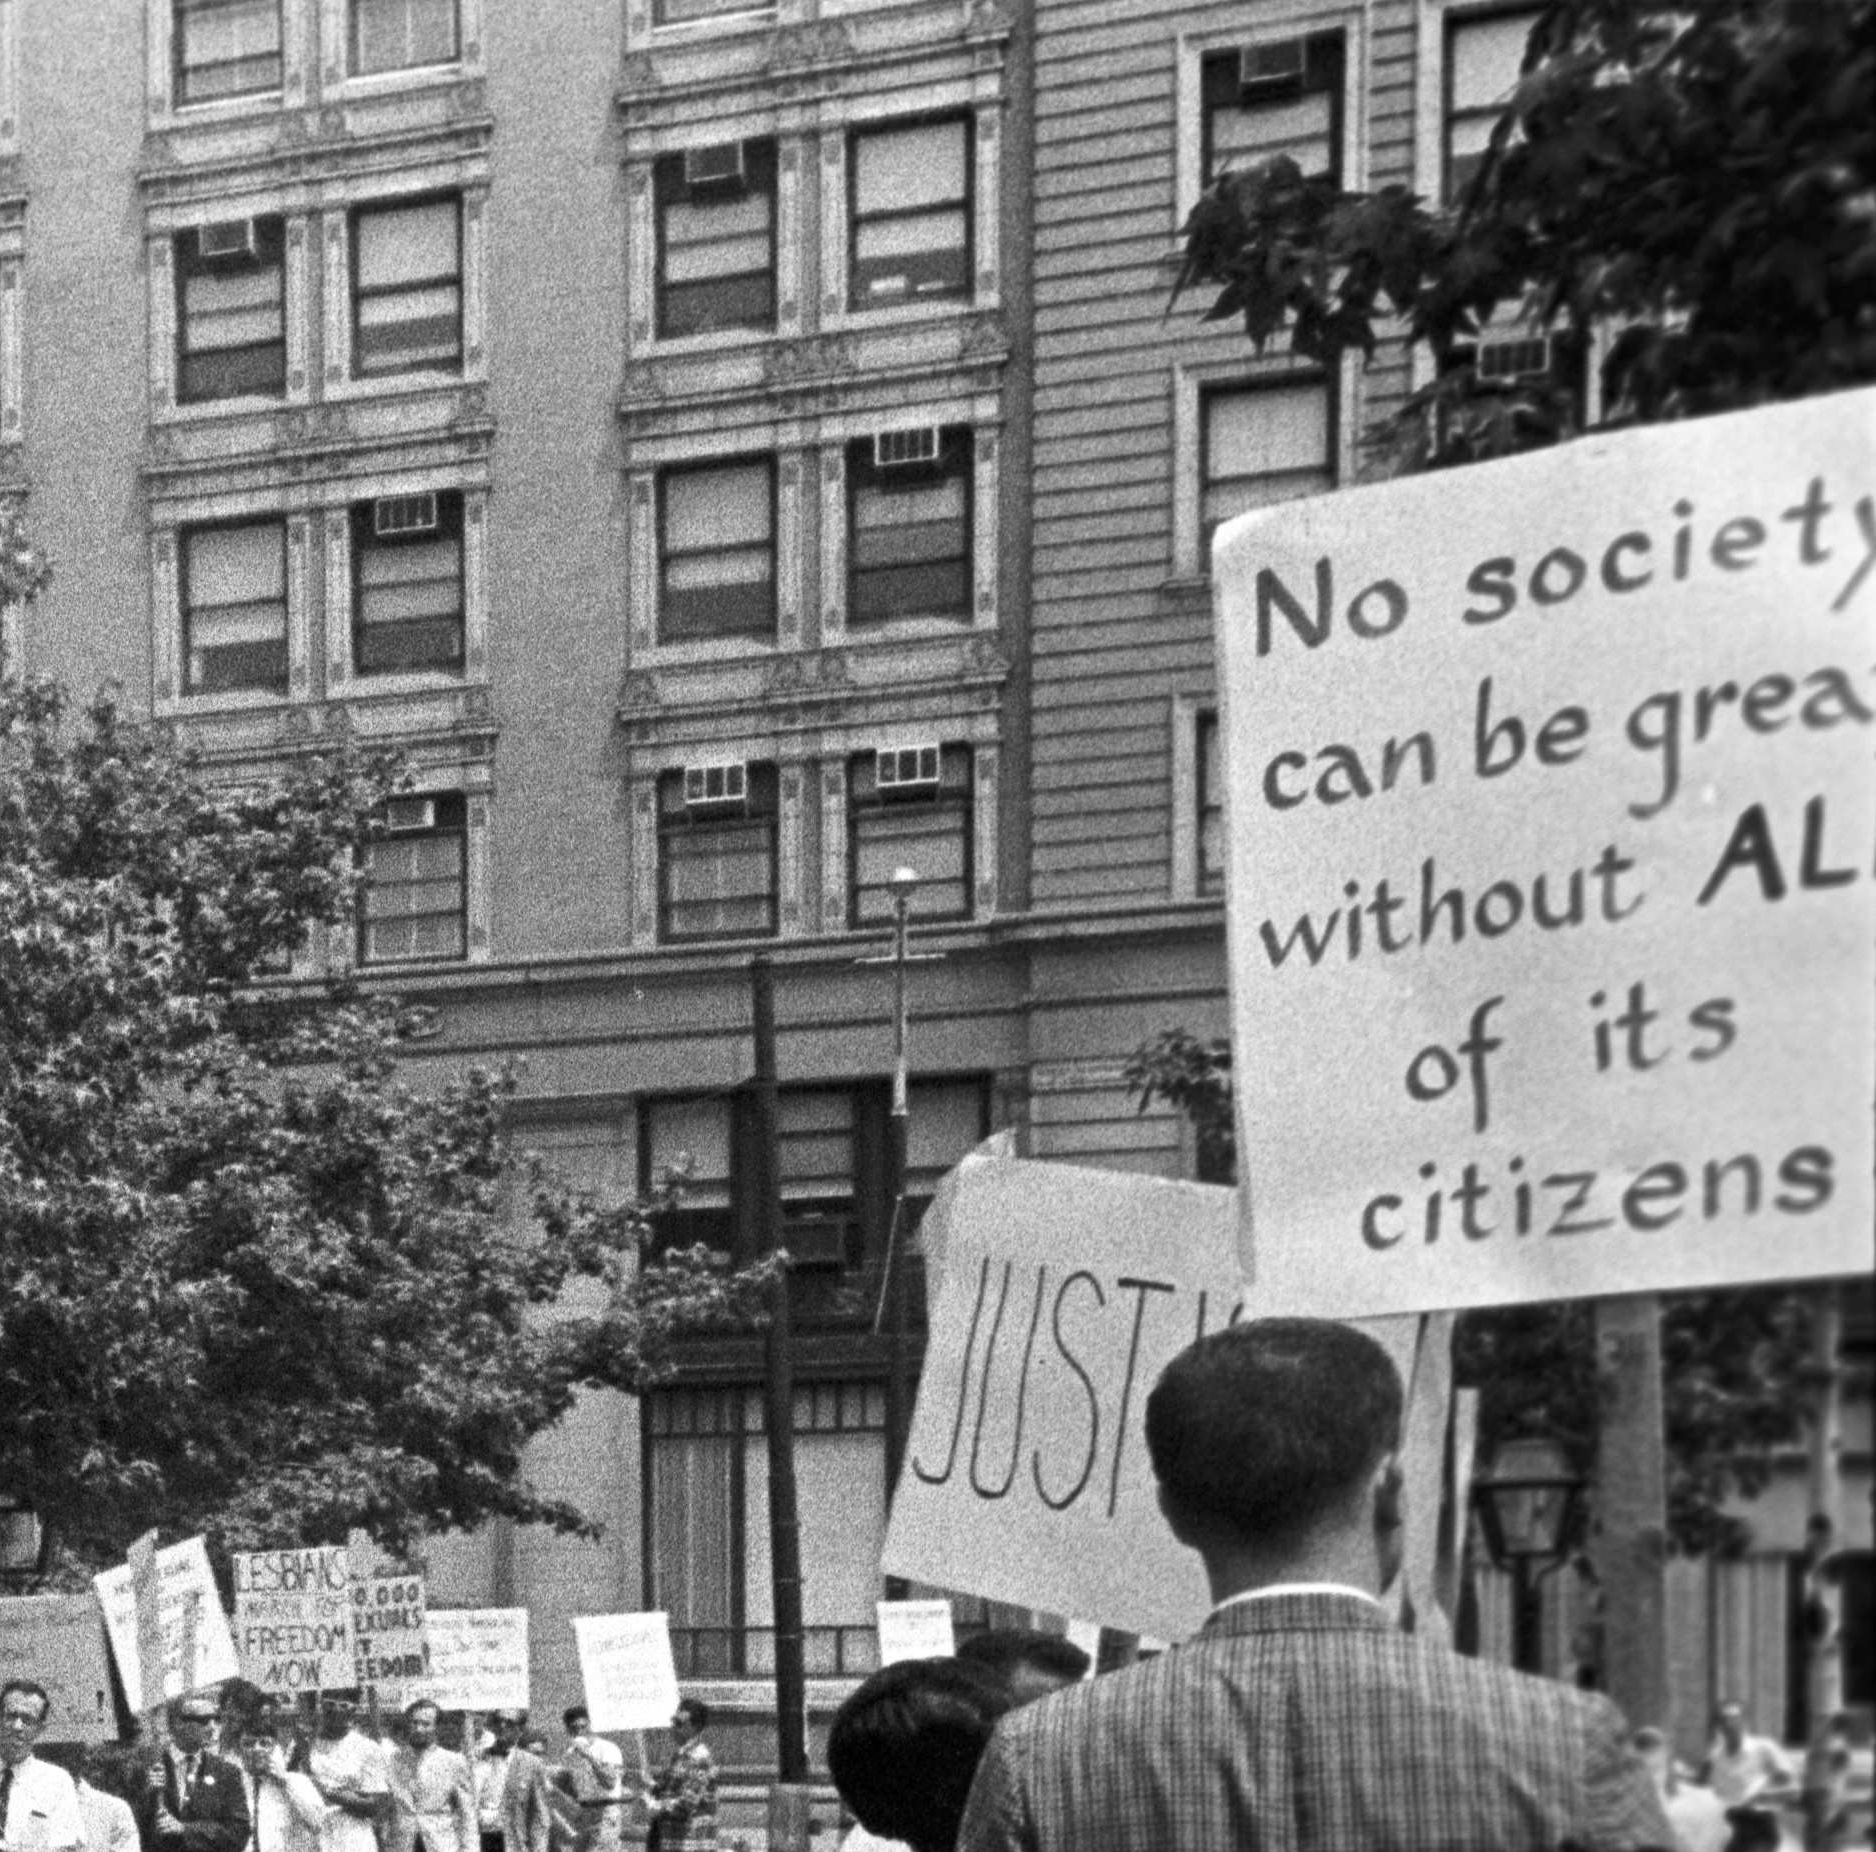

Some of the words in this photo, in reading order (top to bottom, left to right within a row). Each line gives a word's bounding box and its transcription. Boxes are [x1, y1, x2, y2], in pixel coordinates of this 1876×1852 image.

[1256, 555, 1409, 657] No
[1262, 730, 1436, 810] can
[1475, 676, 1590, 778] be
[1625, 666, 1874, 820] grea
[1259, 844, 1646, 968] without
[1696, 795, 1874, 906] AL
[1404, 995, 1505, 1134] of
[1589, 981, 1738, 1073] its
[1360, 1145, 1836, 1251] citizens
[913, 1257, 1244, 1518] JUST
[234, 1548, 347, 1593] LESBIANS
[245, 1624, 347, 1656] FREEDOM
[264, 1657, 323, 1688] NOW
